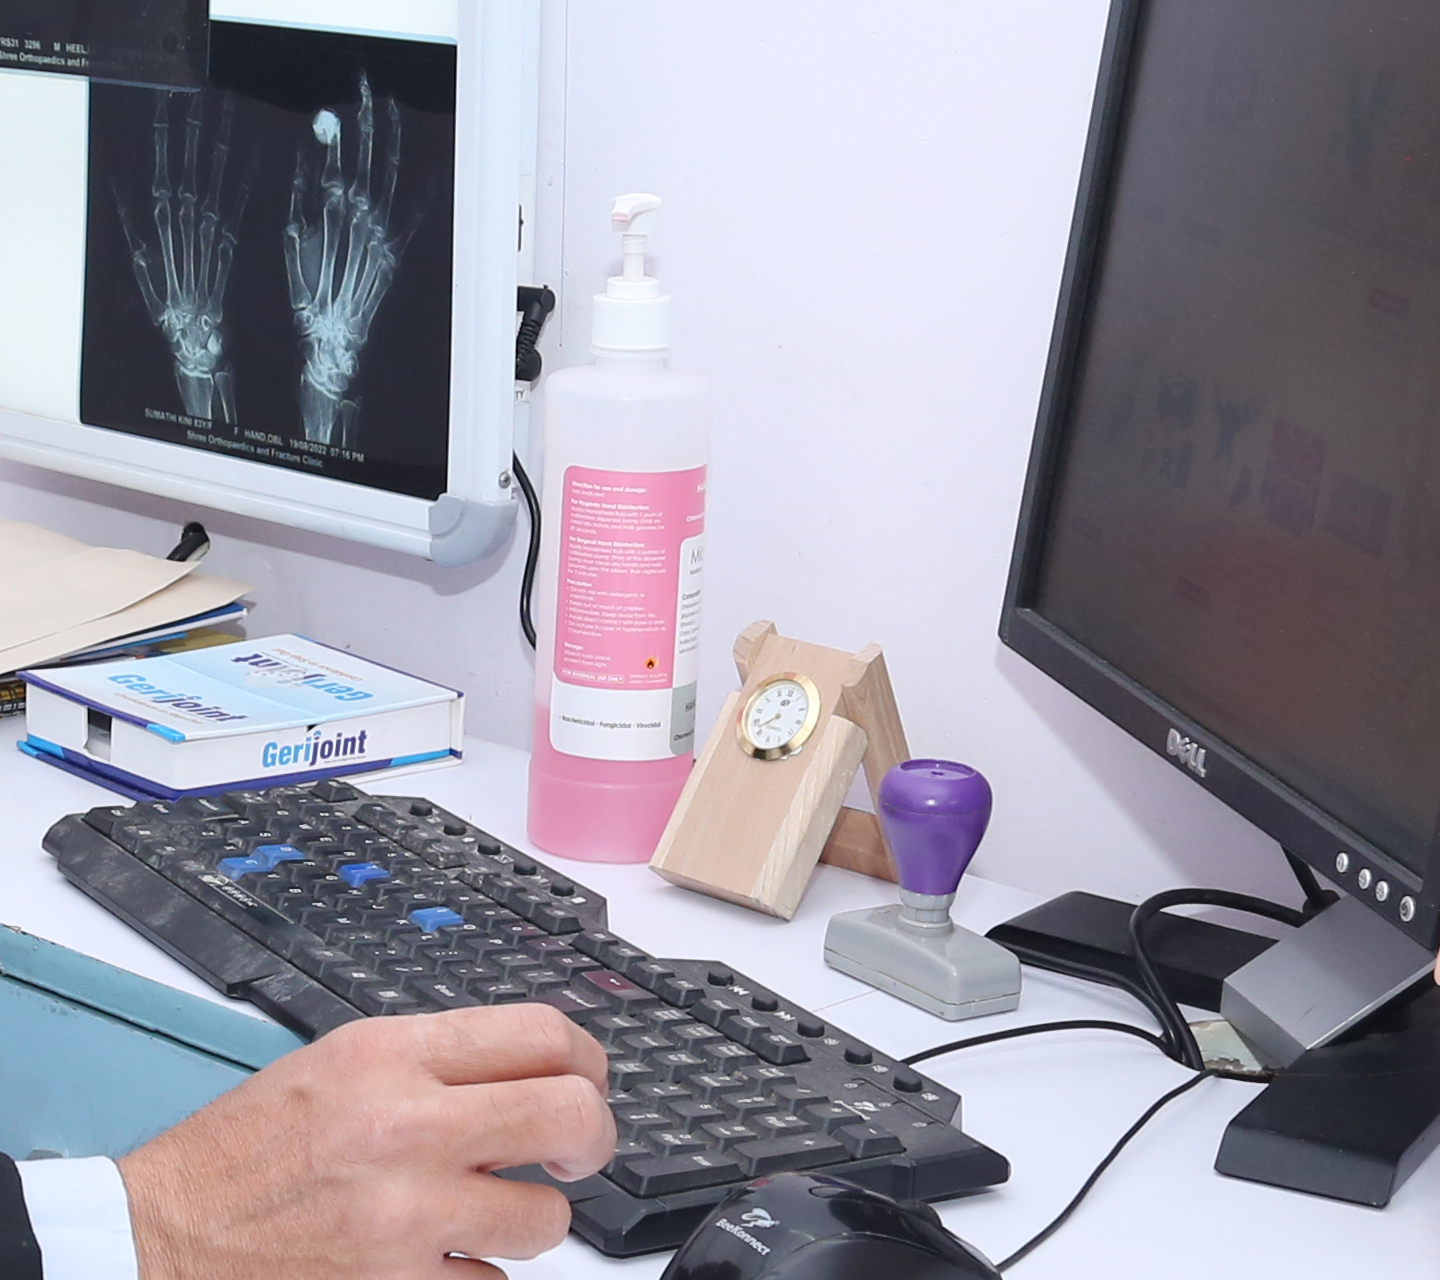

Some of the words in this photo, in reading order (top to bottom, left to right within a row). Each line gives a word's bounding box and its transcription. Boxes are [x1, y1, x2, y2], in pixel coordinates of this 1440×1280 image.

[19, 52, 64, 66] Orthopaedics
[66, 55, 80, 67] and
[187, 429, 207, 443] Shree
[208, 433, 255, 454] Orthopaedics
[256, 445, 270, 456] and
[270, 447, 301, 463] Fracture
[302, 454, 323, 467] Clinic
[351, 451, 365, 463] PM
[107, 673, 250, 722] Gerijoint
[262, 728, 368, 769] Gerijoint
[1166, 728, 1207, 778] DELL
